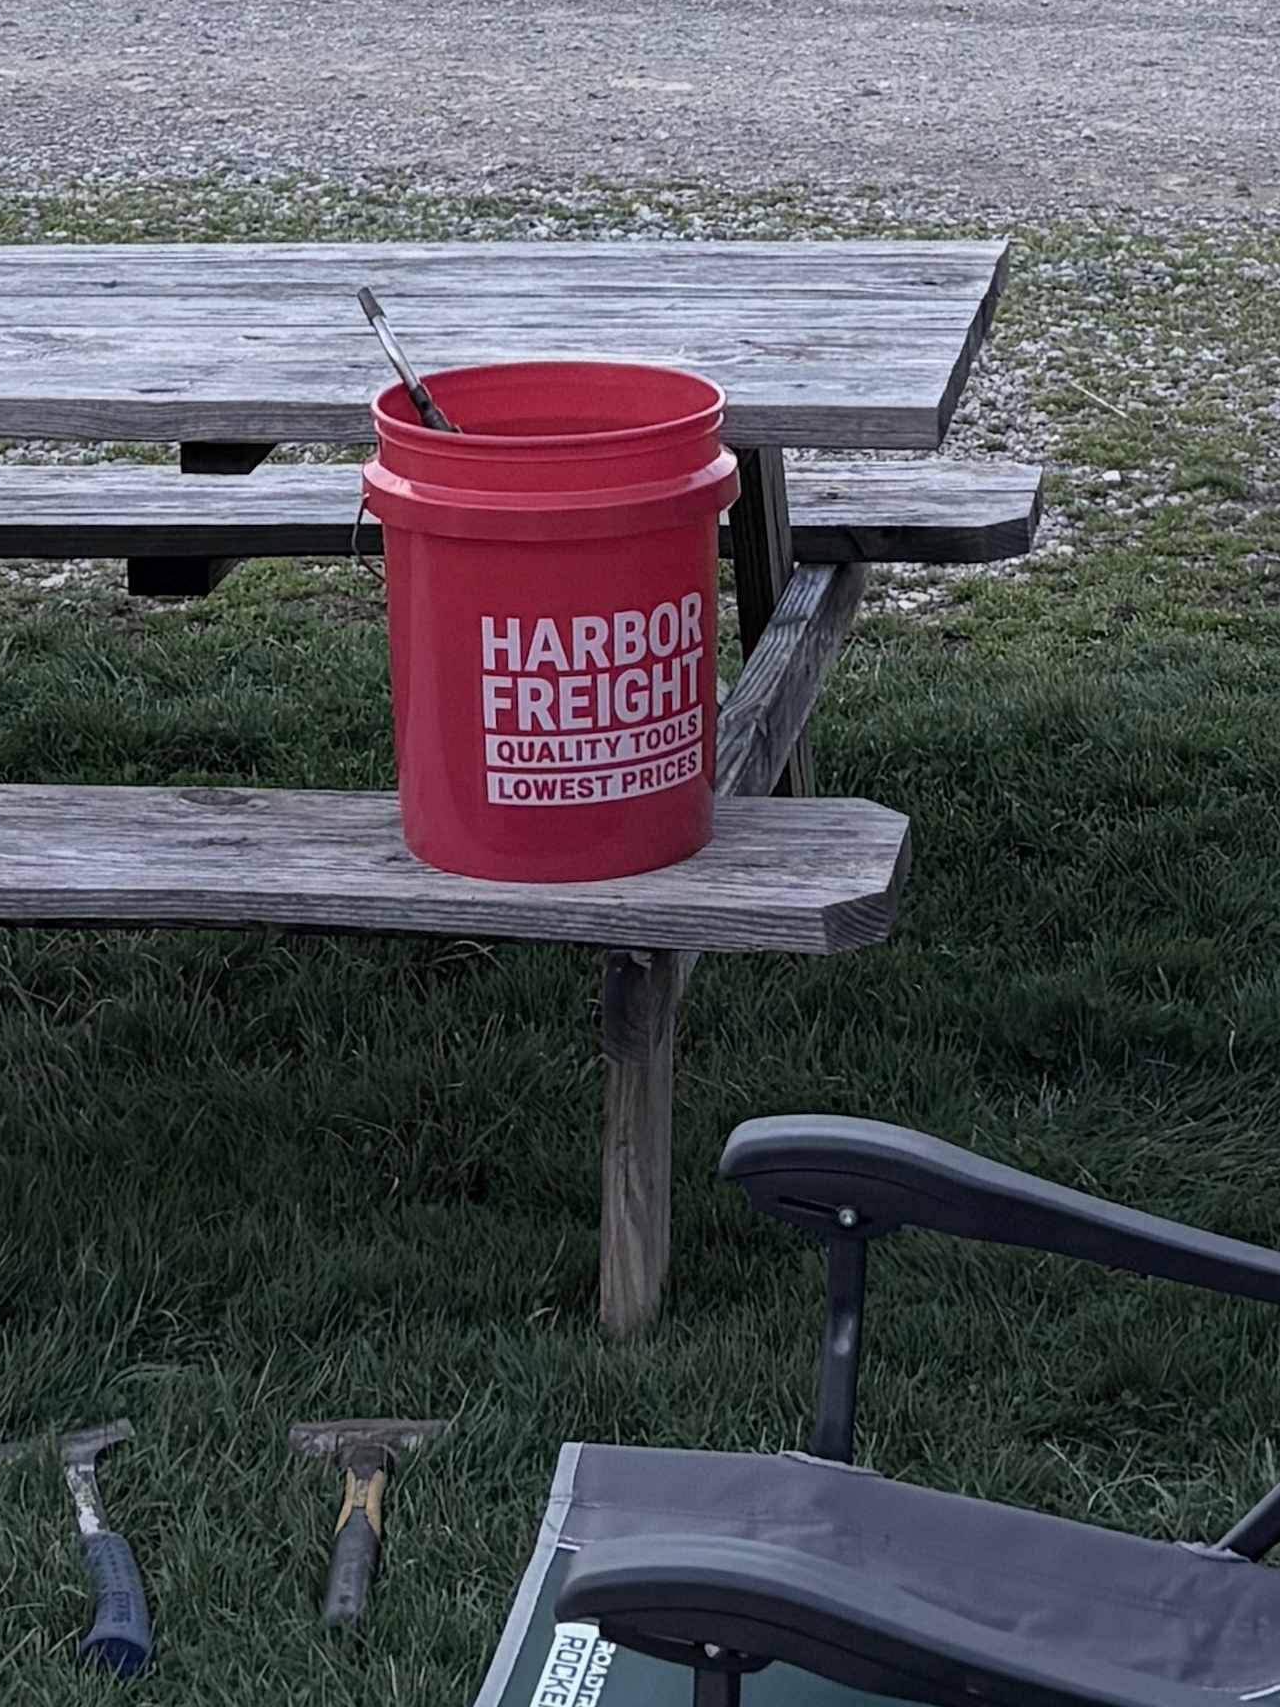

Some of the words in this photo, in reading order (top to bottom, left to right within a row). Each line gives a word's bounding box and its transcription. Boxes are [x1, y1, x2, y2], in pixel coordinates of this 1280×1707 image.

[481, 591, 702, 672] HARBOR
[482, 646, 704, 731] FREIGHT
[496, 735, 622, 764] QUALITY
[630, 713, 698, 753] TOOLS
[498, 775, 613, 800] LOWEST
[622, 751, 698, 793] PRICES
[538, 1634, 588, 1707] ROCKE
